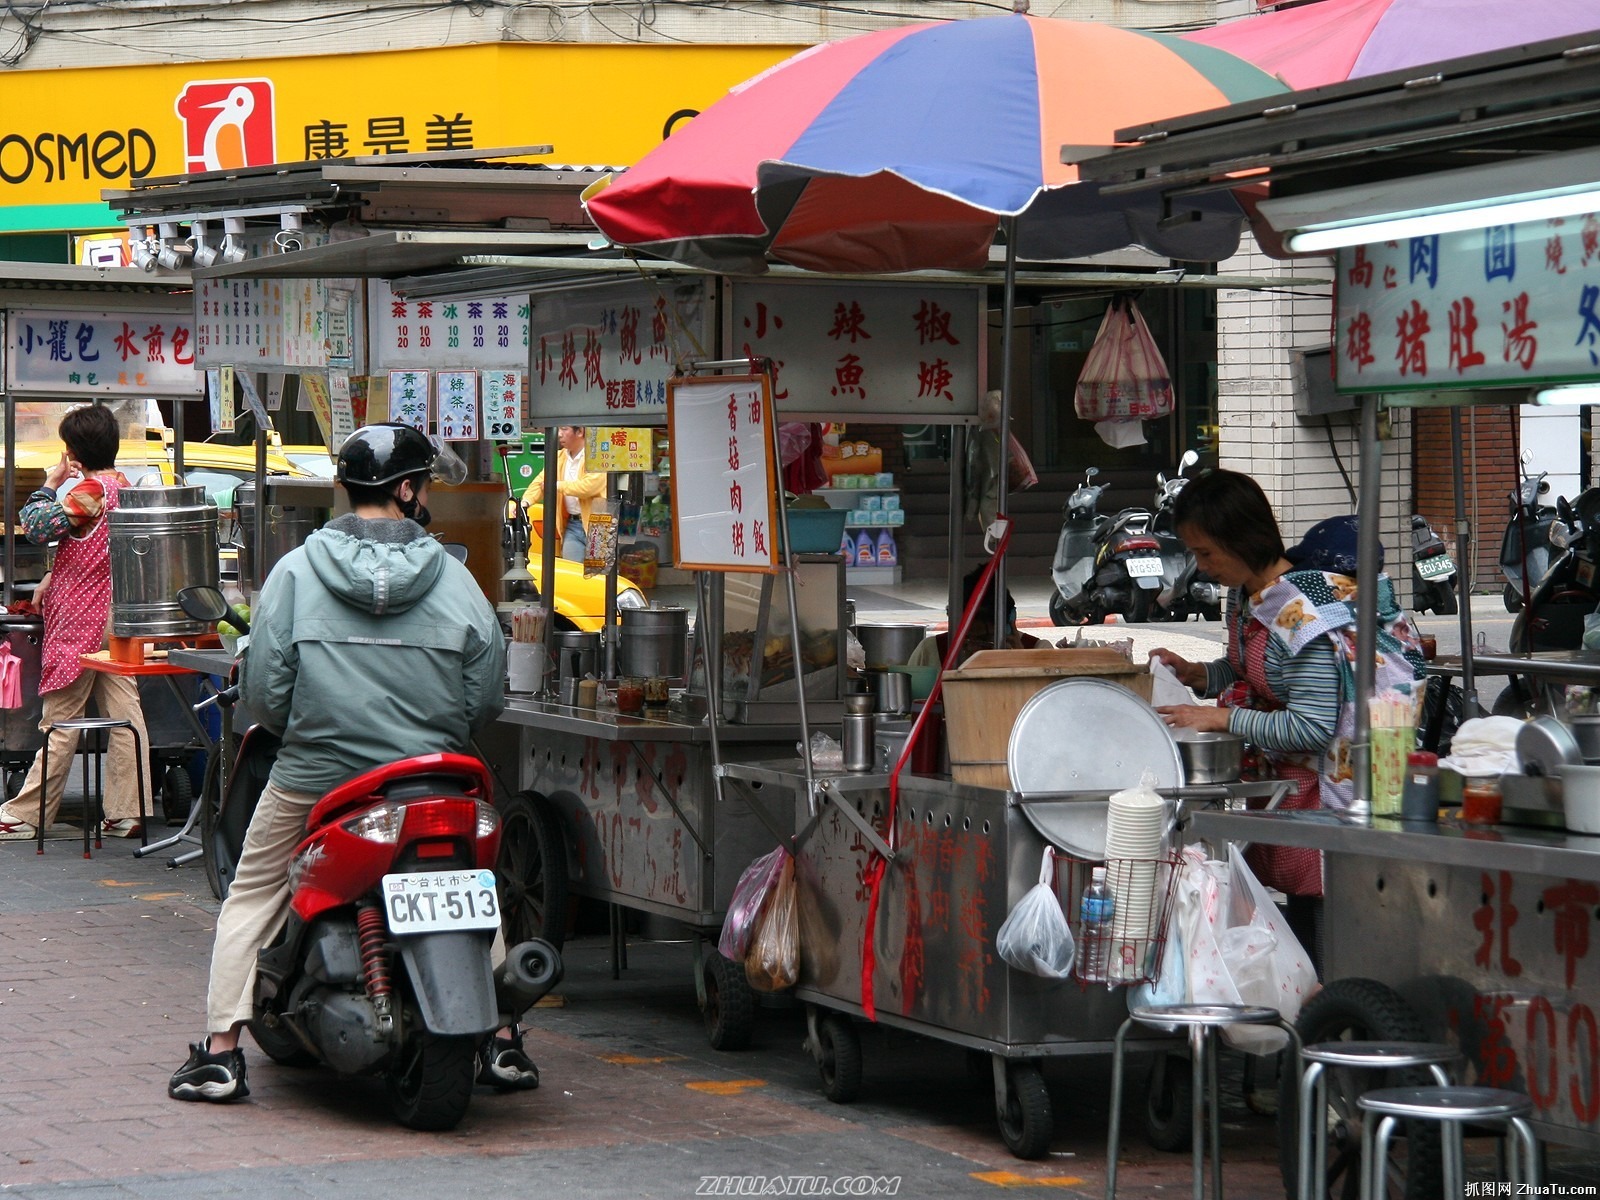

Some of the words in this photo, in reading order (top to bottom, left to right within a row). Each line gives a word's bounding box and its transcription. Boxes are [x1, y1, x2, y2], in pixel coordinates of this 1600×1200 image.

[304, 112, 473, 160] 康是美
[391, 301, 407, 318] 茶
[417, 301, 433, 318] 茶
[442, 303, 458, 319] 冰
[467, 302, 483, 319] 茶
[492, 302, 508, 319] 茶
[743, 300, 960, 346] 小辣椒
[1347, 245, 1375, 374] 高雄
[18, 319, 100, 363] 小籠包
[113, 321, 195, 366] 水煎包
[397, 337, 409, 348] 20
[419, 336, 431, 347] 20
[448, 337, 459, 347] 20
[473, 337, 484, 347] 20
[497, 337, 509, 347] 40
[398, 325, 408, 336] 10
[419, 325, 430, 336] 10
[448, 325, 459, 336] 10
[473, 325, 484, 336] 10
[497, 325, 509, 336] 20
[536, 327, 606, 392] 小辣椒
[68, 371, 99, 386] 肉包
[402, 373, 417, 415] 青草茶
[450, 377, 465, 409] 綠茶
[606, 379, 637, 410] 乾麵
[502, 373, 516, 419] 海燕窩
[443, 426, 453, 436] 10
[461, 425, 472, 435] 20
[491, 422, 515, 435] 50
[727, 393, 745, 558] 香菇肉粥
[748, 392, 768, 557] 油飯
[1418, 559, 1453, 575] ECU-345
[420, 875, 460, 888] 台北市
